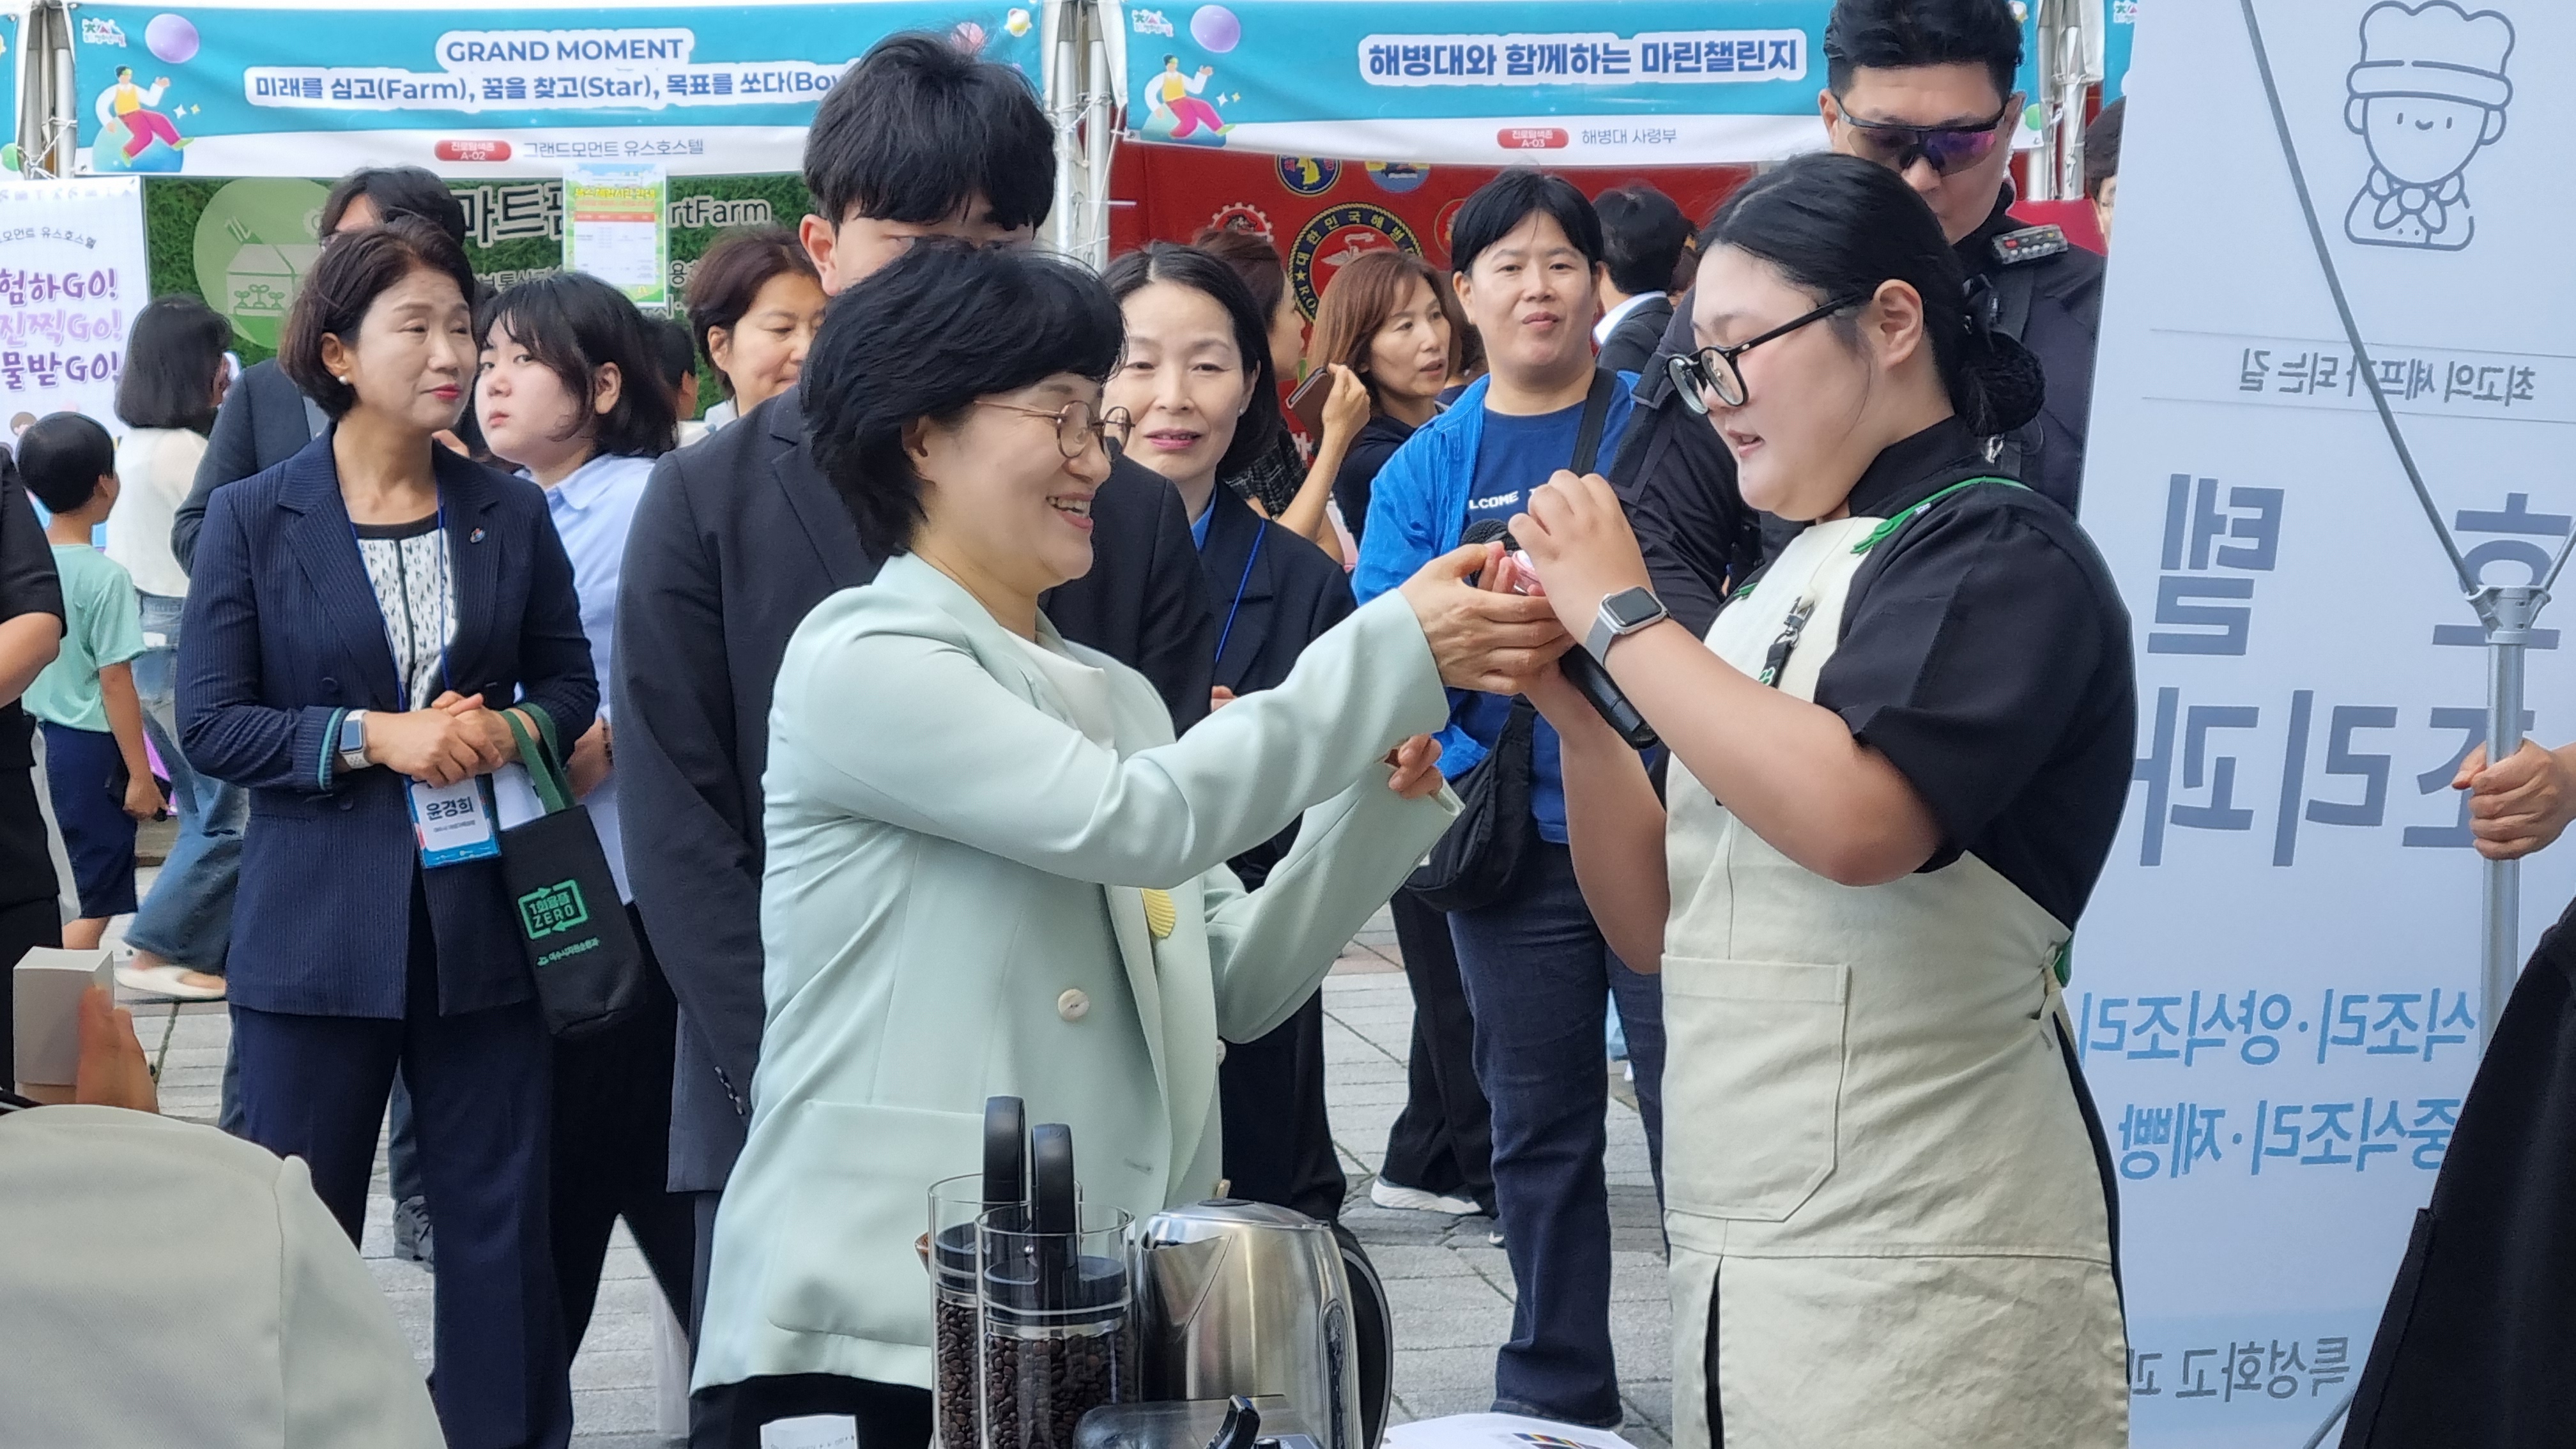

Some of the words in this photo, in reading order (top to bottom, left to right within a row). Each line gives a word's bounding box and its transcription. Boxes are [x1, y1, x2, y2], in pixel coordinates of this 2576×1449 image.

[447, 40, 549, 62] GRAND
[556, 38, 684, 61] MOMENT
[1368, 43, 1497, 77] 해병대와
[1505, 42, 1632, 75] 함께하는
[1641, 38, 1797, 73] 마린챌린지
[256, 77, 323, 100] 미래를
[330, 77, 475, 102] 심고(Farm),
[482, 77, 527, 100] 꿈을
[533, 75, 660, 100] 찾고(Star),
[666, 73, 733, 96] 목표를
[523, 141, 619, 158] 그랜드모먼트
[624, 138, 704, 157] 유스호스텔
[1521, 139, 1545, 148] A-03
[1581, 128, 1627, 145] 해병대
[1631, 128, 1677, 144] 사령부
[461, 151, 486, 160] A-02
[671, 199, 768, 224] rtFarm
[0, 226, 36, 243] 모먼트
[40, 226, 97, 250] 유스호스텔
[0, 268, 118, 305] 험하GO!
[1469, 490, 1520, 510] LCOME
[426, 796, 474, 821] 윤경희
[533, 904, 574, 928] ZERO
